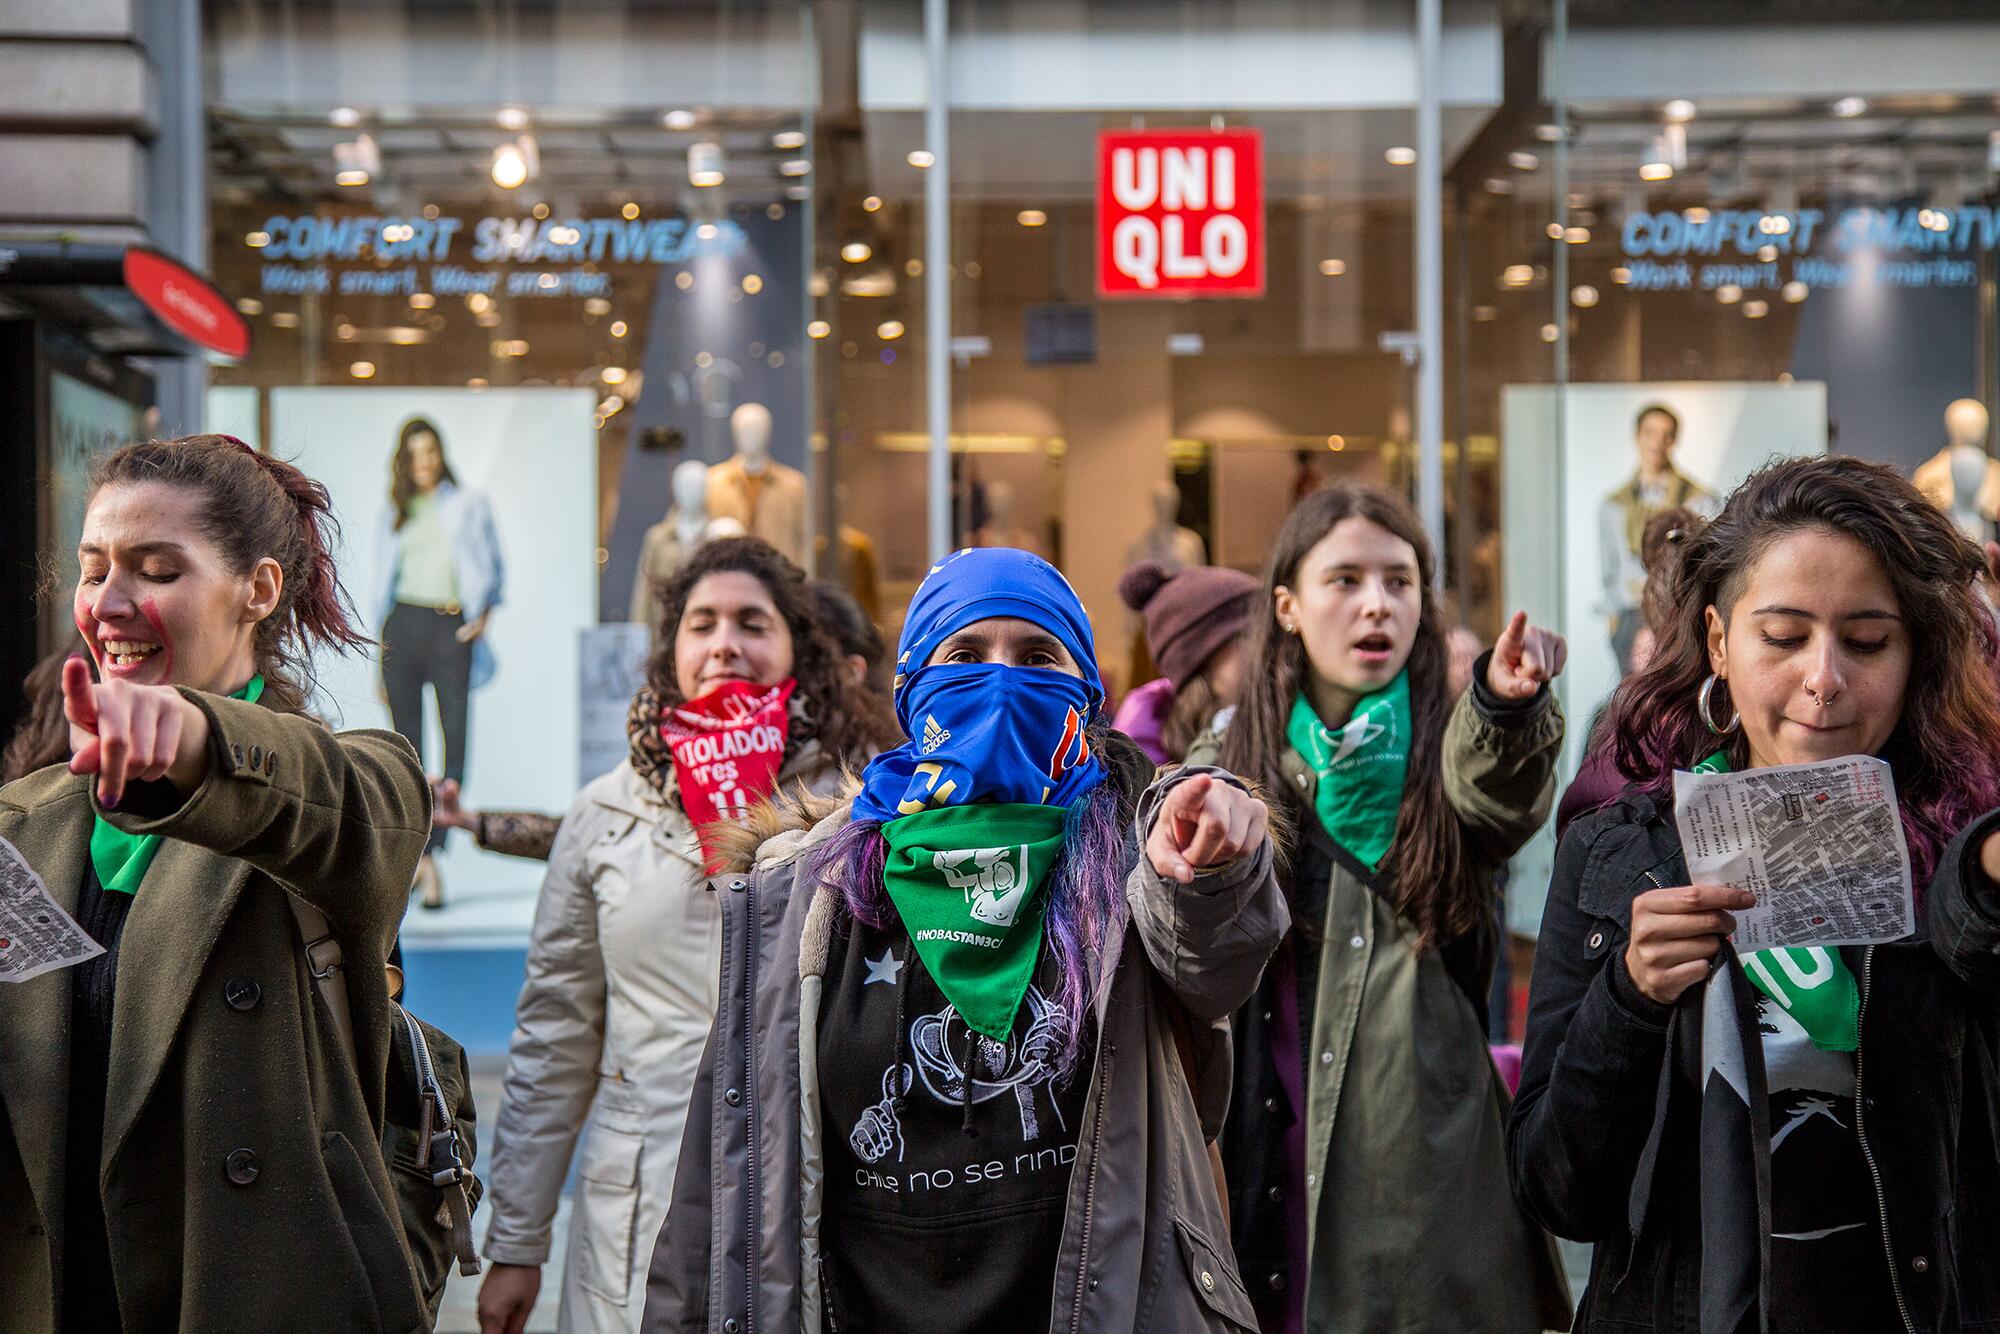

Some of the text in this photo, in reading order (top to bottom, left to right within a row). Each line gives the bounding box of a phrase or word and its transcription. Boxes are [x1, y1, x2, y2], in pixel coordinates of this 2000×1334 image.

[1112, 146, 1236, 211] UNI
[262, 215, 463, 261] COMFORT
[1622, 208, 1825, 256] COMFORT
[1112, 214, 1248, 289] QLO
[922, 729, 952, 755] adidas
[1712, 833, 1724, 854] STAMP
[916, 929, 1004, 949] #NOBASTAN3C
[909, 1169, 954, 1192] no
[964, 1161, 1004, 1183] se
